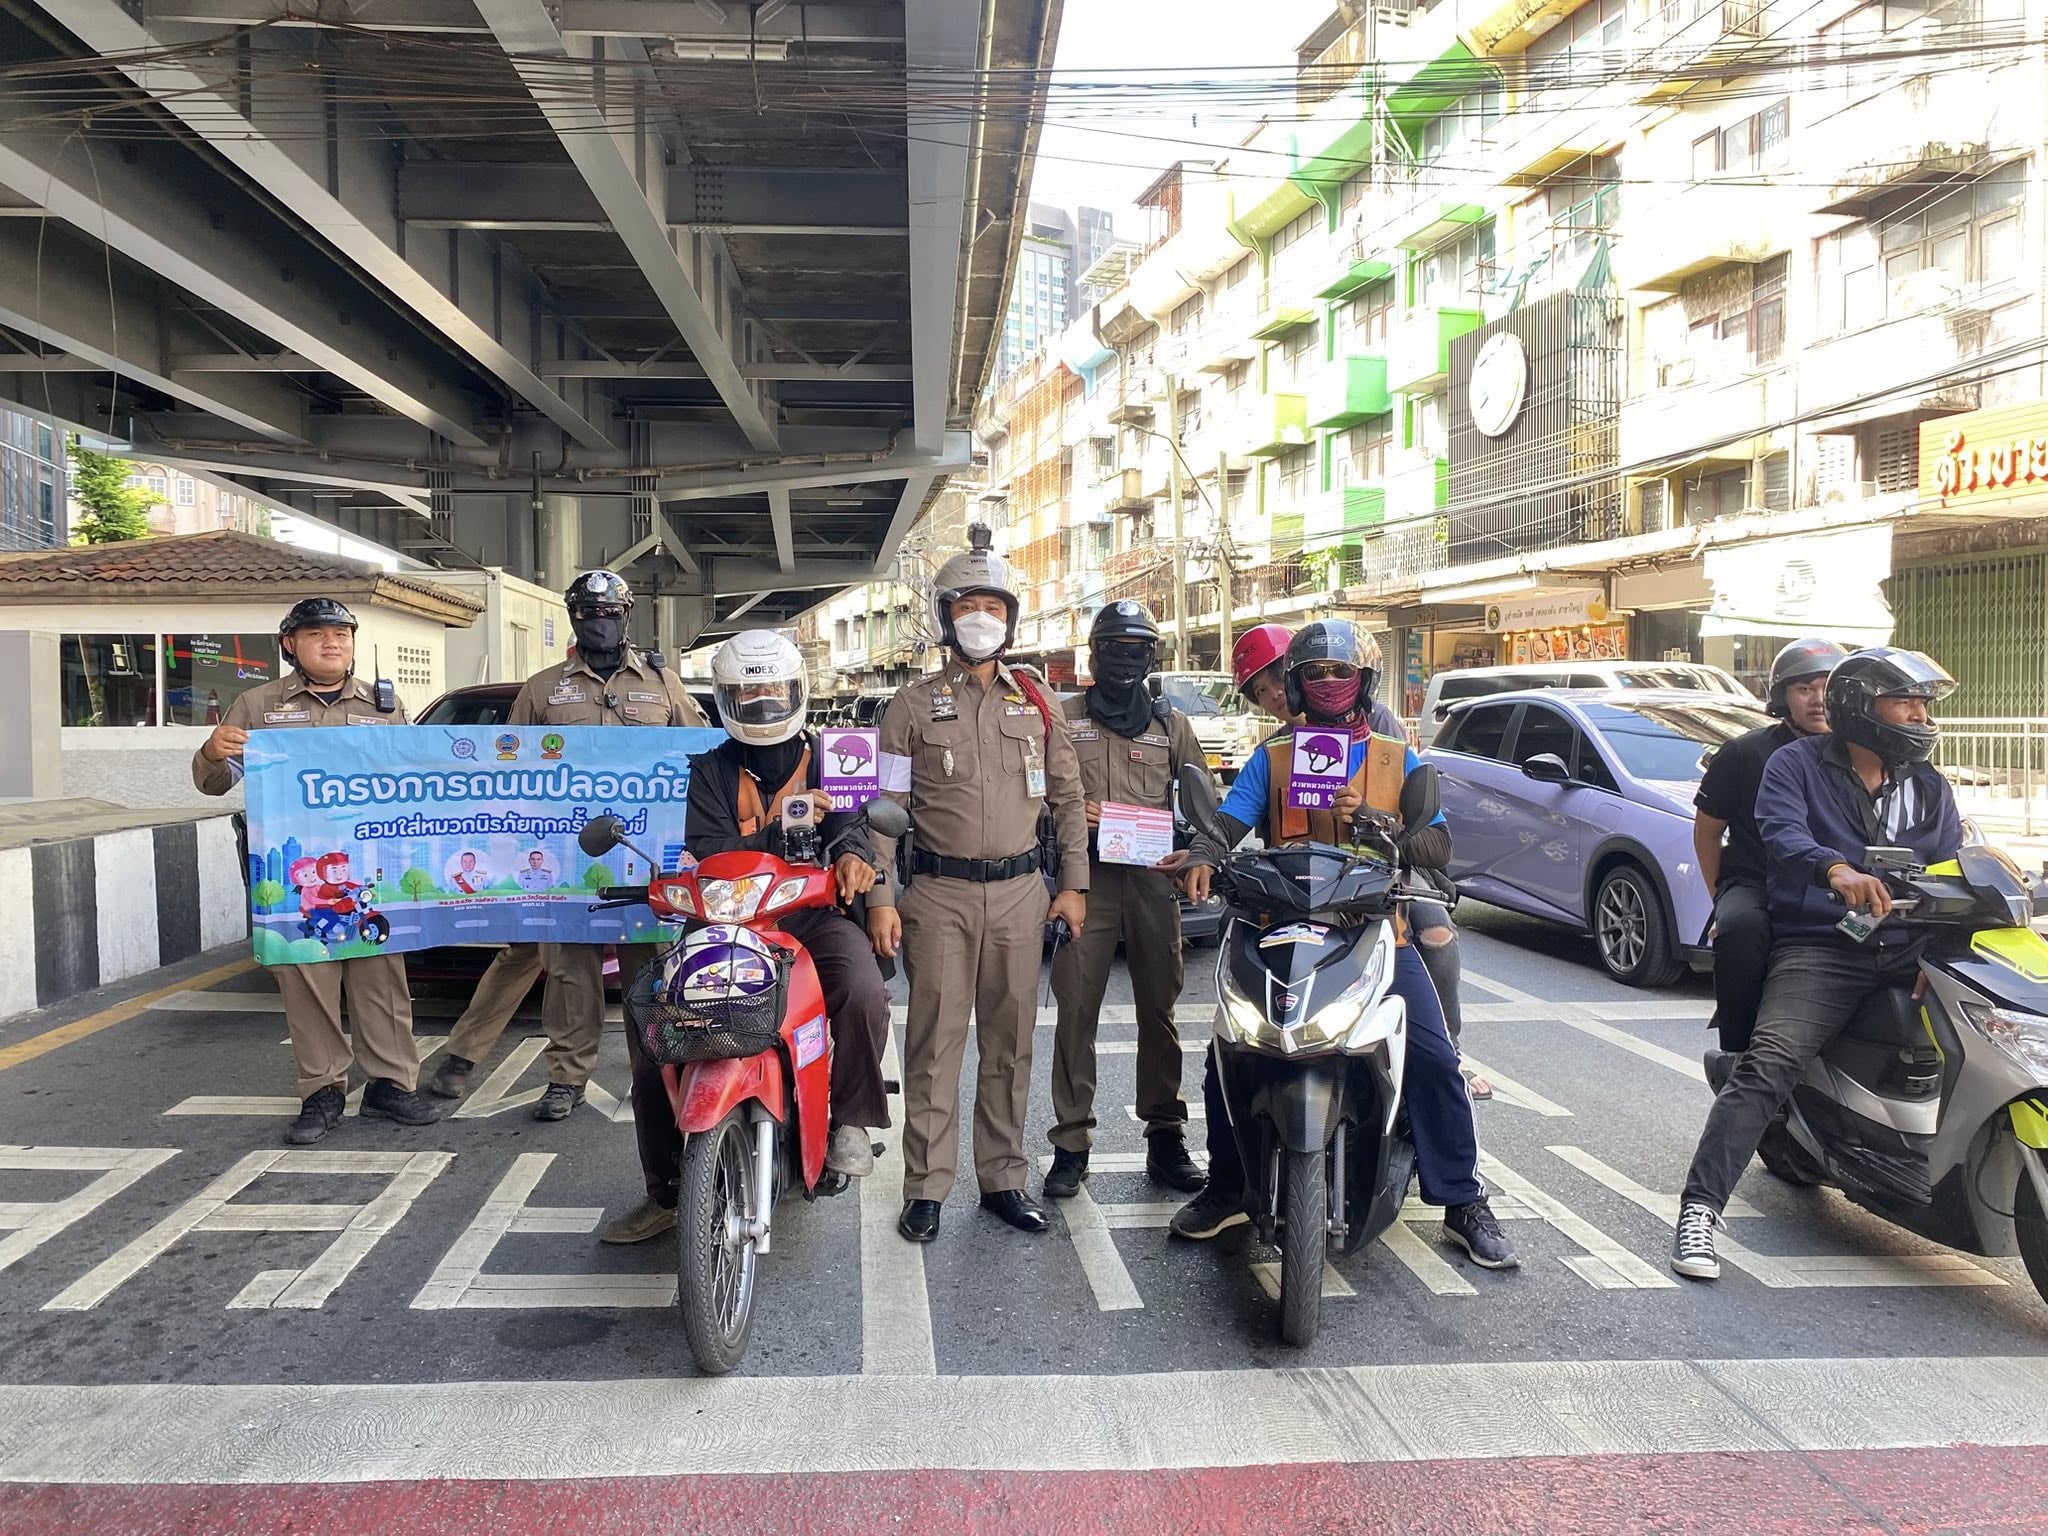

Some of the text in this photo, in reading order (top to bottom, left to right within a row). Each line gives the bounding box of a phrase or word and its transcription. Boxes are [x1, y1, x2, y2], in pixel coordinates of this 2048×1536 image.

[1311, 636, 1340, 646] INDEX
[745, 666, 776, 676] INDEX
[1380, 753, 1391, 766] 3
[831, 794, 853, 809] 100
[1296, 791, 1321, 806] 100
